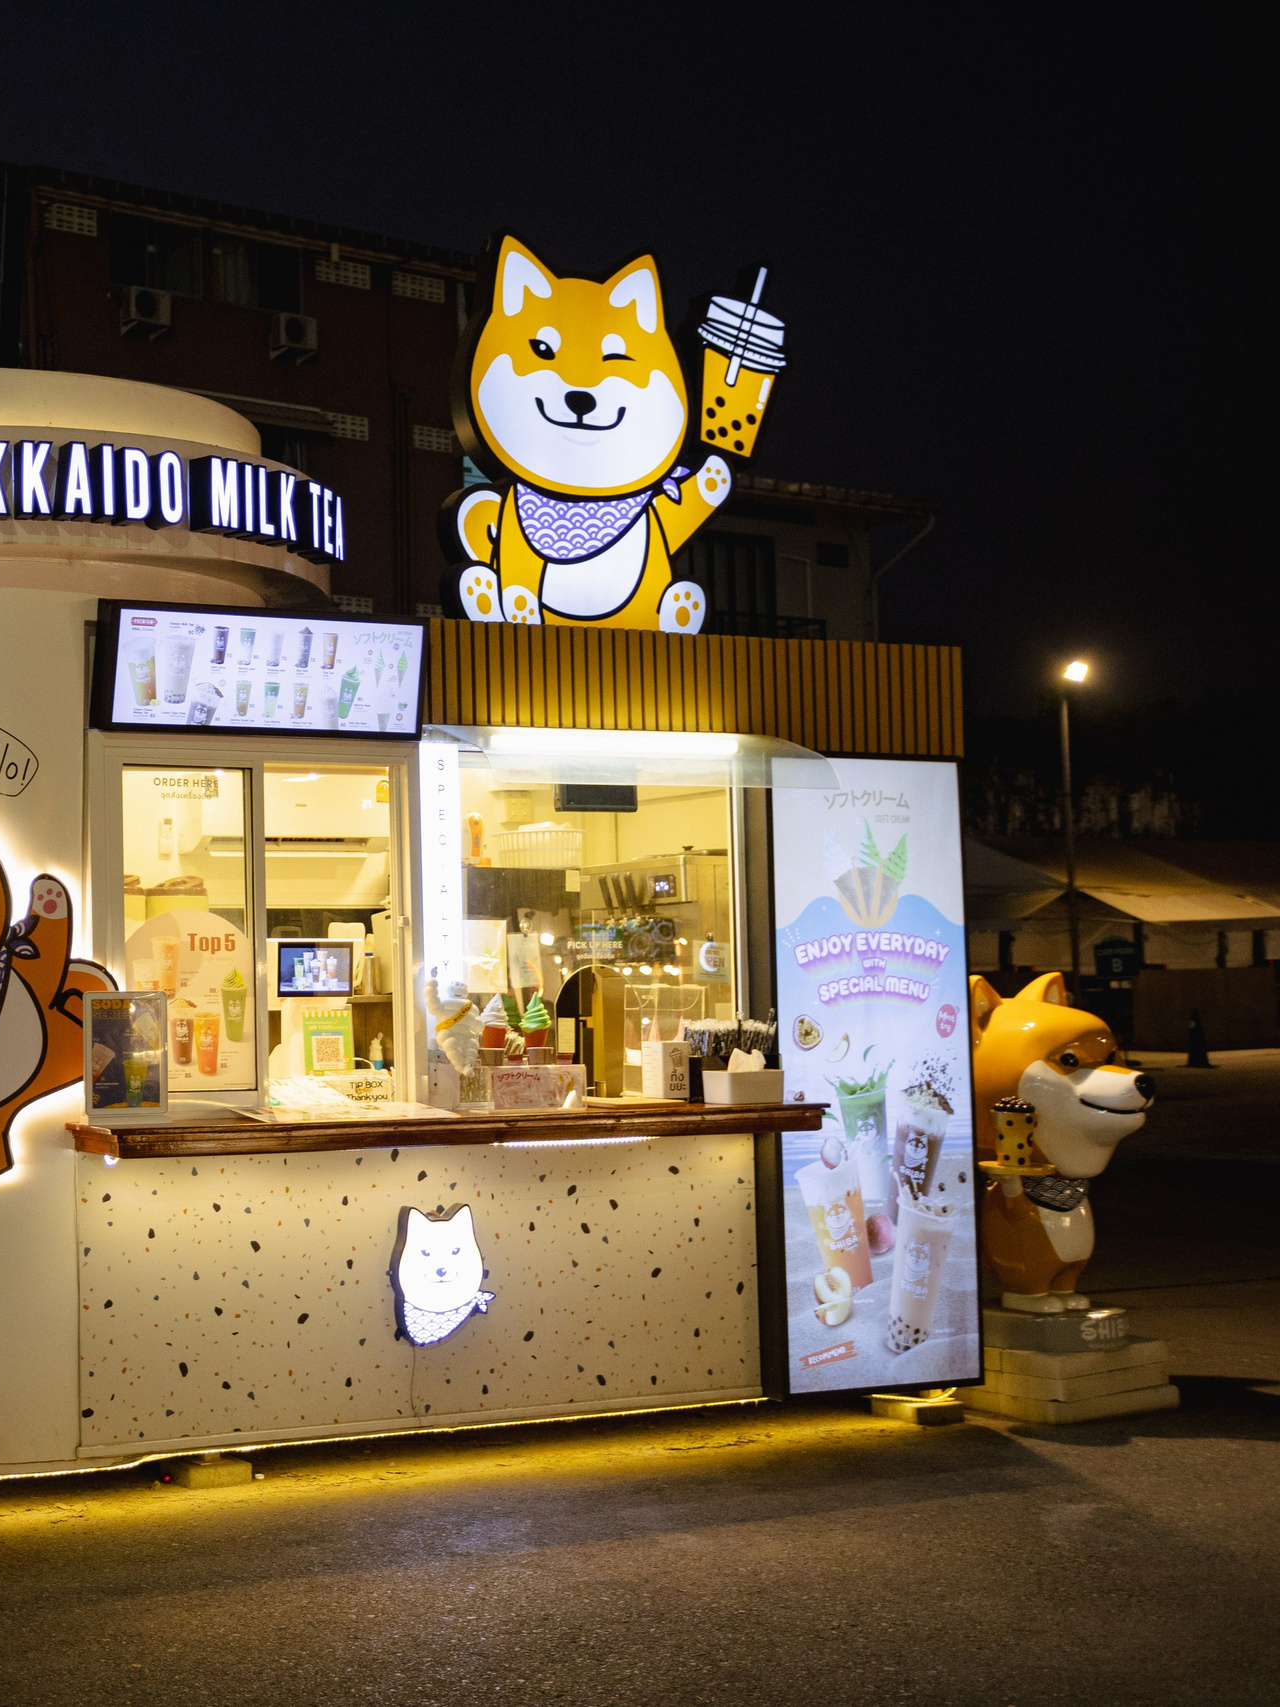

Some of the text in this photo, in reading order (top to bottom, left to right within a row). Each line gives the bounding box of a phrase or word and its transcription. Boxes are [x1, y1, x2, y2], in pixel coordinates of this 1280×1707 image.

[210, 457, 298, 543] MILK
[308, 480, 345, 562] TEA
[153, 777, 218, 788] ORDER HERE
[823, 789, 910, 810] ソフトクリーム
[874, 814, 911, 824] SOFT CREAM
[187, 933, 236, 955] Top 5
[567, 940, 623, 950] PICK UP HERE
[794, 931, 950, 966] ENJOY EVERYDAY
[862, 957, 887, 969] WITH
[818, 975, 930, 1002] SPECIAL MENU
[496, 1071, 541, 1082] ソフトクリーム
[349, 1080, 383, 1089] TIP BOX
[669, 1082, 687, 1092] ขยะ
[829, 1234, 859, 1251] SHIBA
